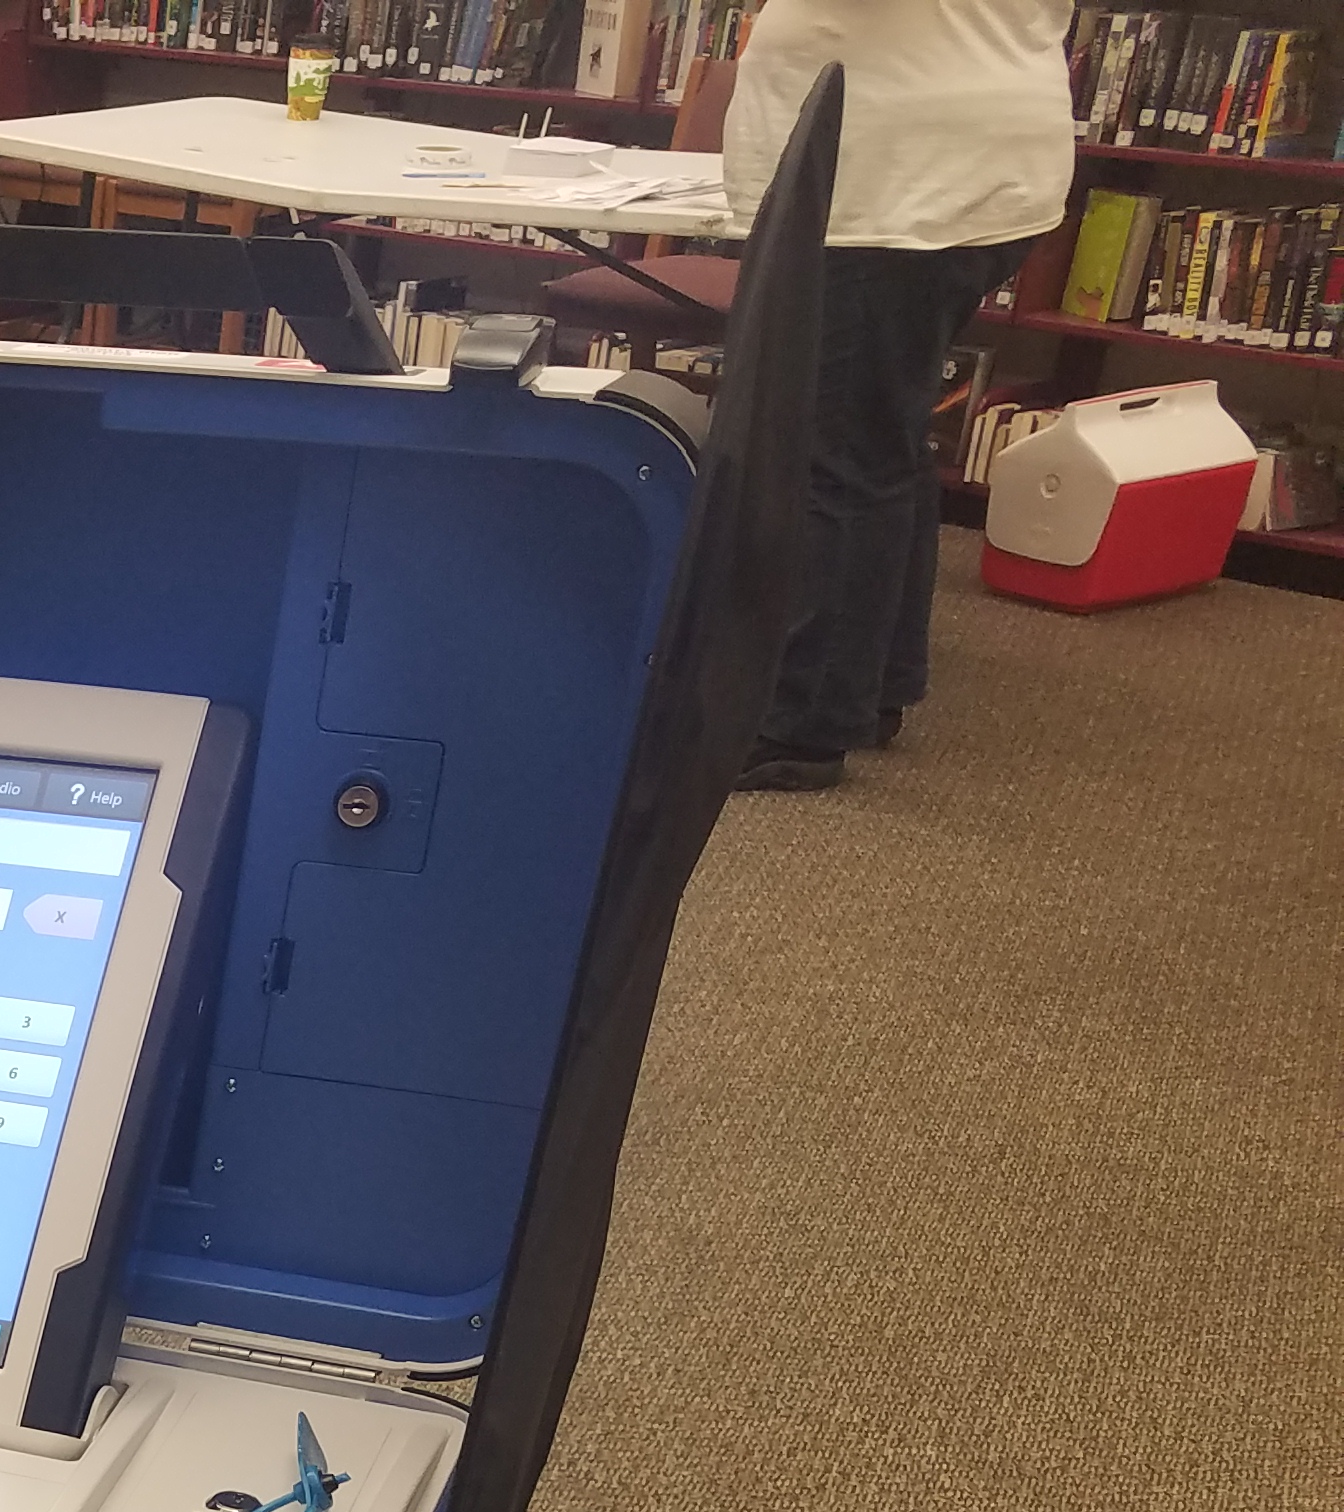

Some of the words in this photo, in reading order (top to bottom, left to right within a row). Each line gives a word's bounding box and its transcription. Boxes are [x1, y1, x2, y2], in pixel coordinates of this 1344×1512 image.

[1188, 248, 1207, 292] REALITY
[90, 790, 123, 808] Help
[21, 1015, 31, 1029] 3
[8, 1067, 18, 1080] 6
